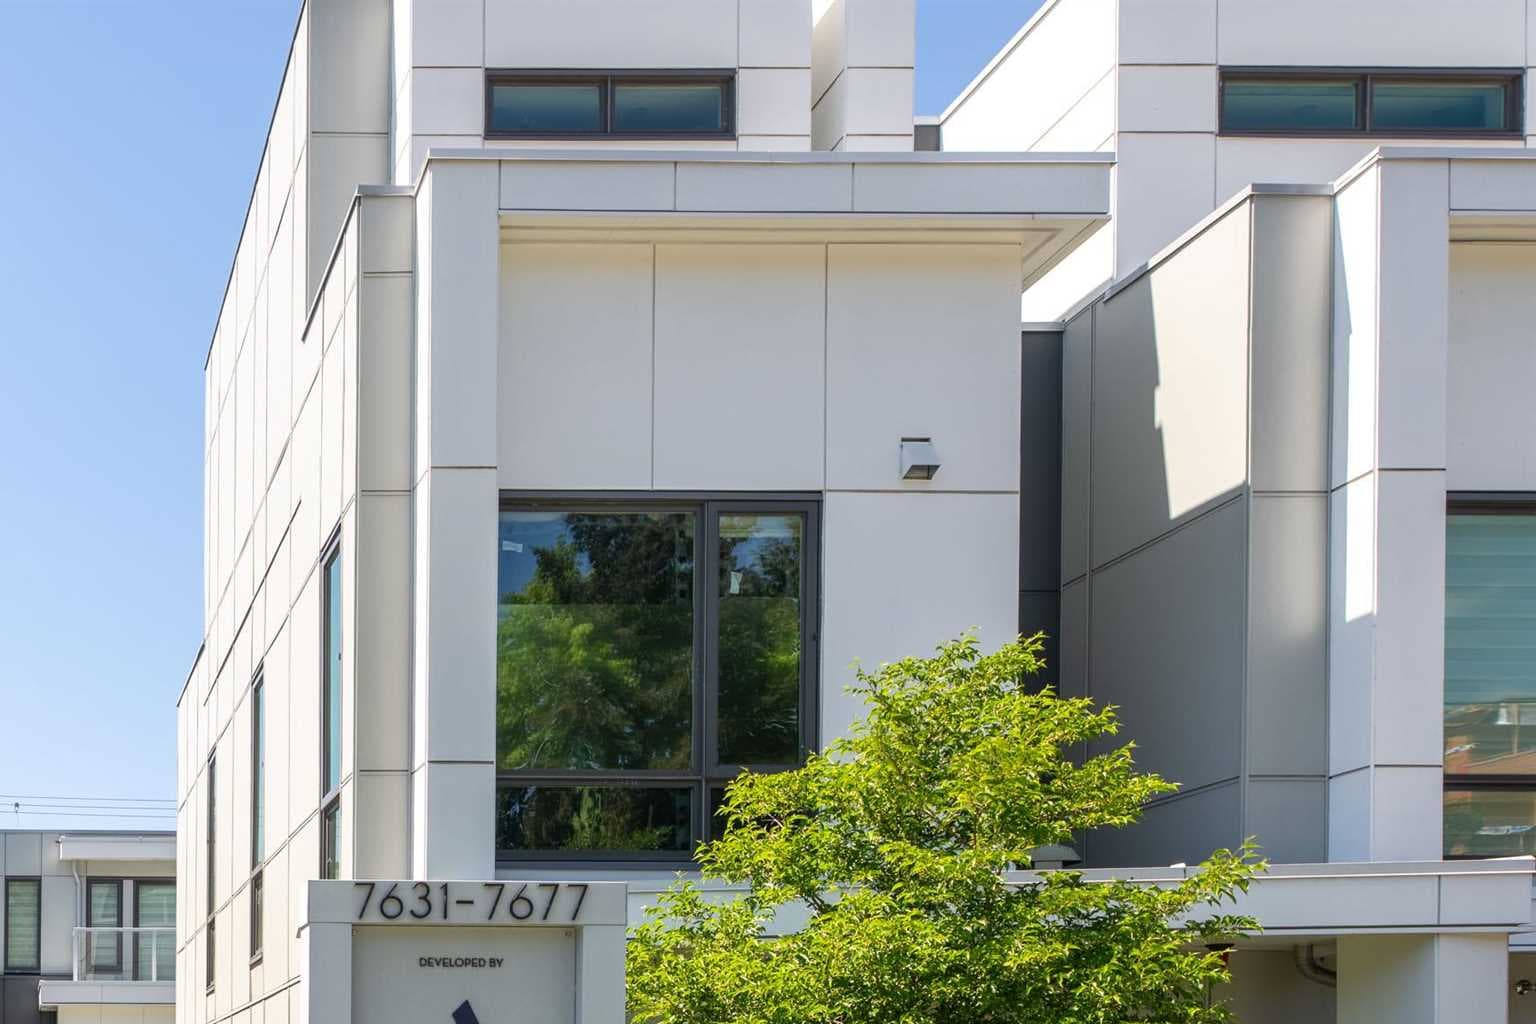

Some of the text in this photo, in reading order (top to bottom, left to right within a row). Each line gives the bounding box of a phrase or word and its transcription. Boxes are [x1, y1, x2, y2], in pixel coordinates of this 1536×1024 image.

[353, 882, 590, 921] 7631-7677
[419, 957, 504, 969] DEVELOPED BY
